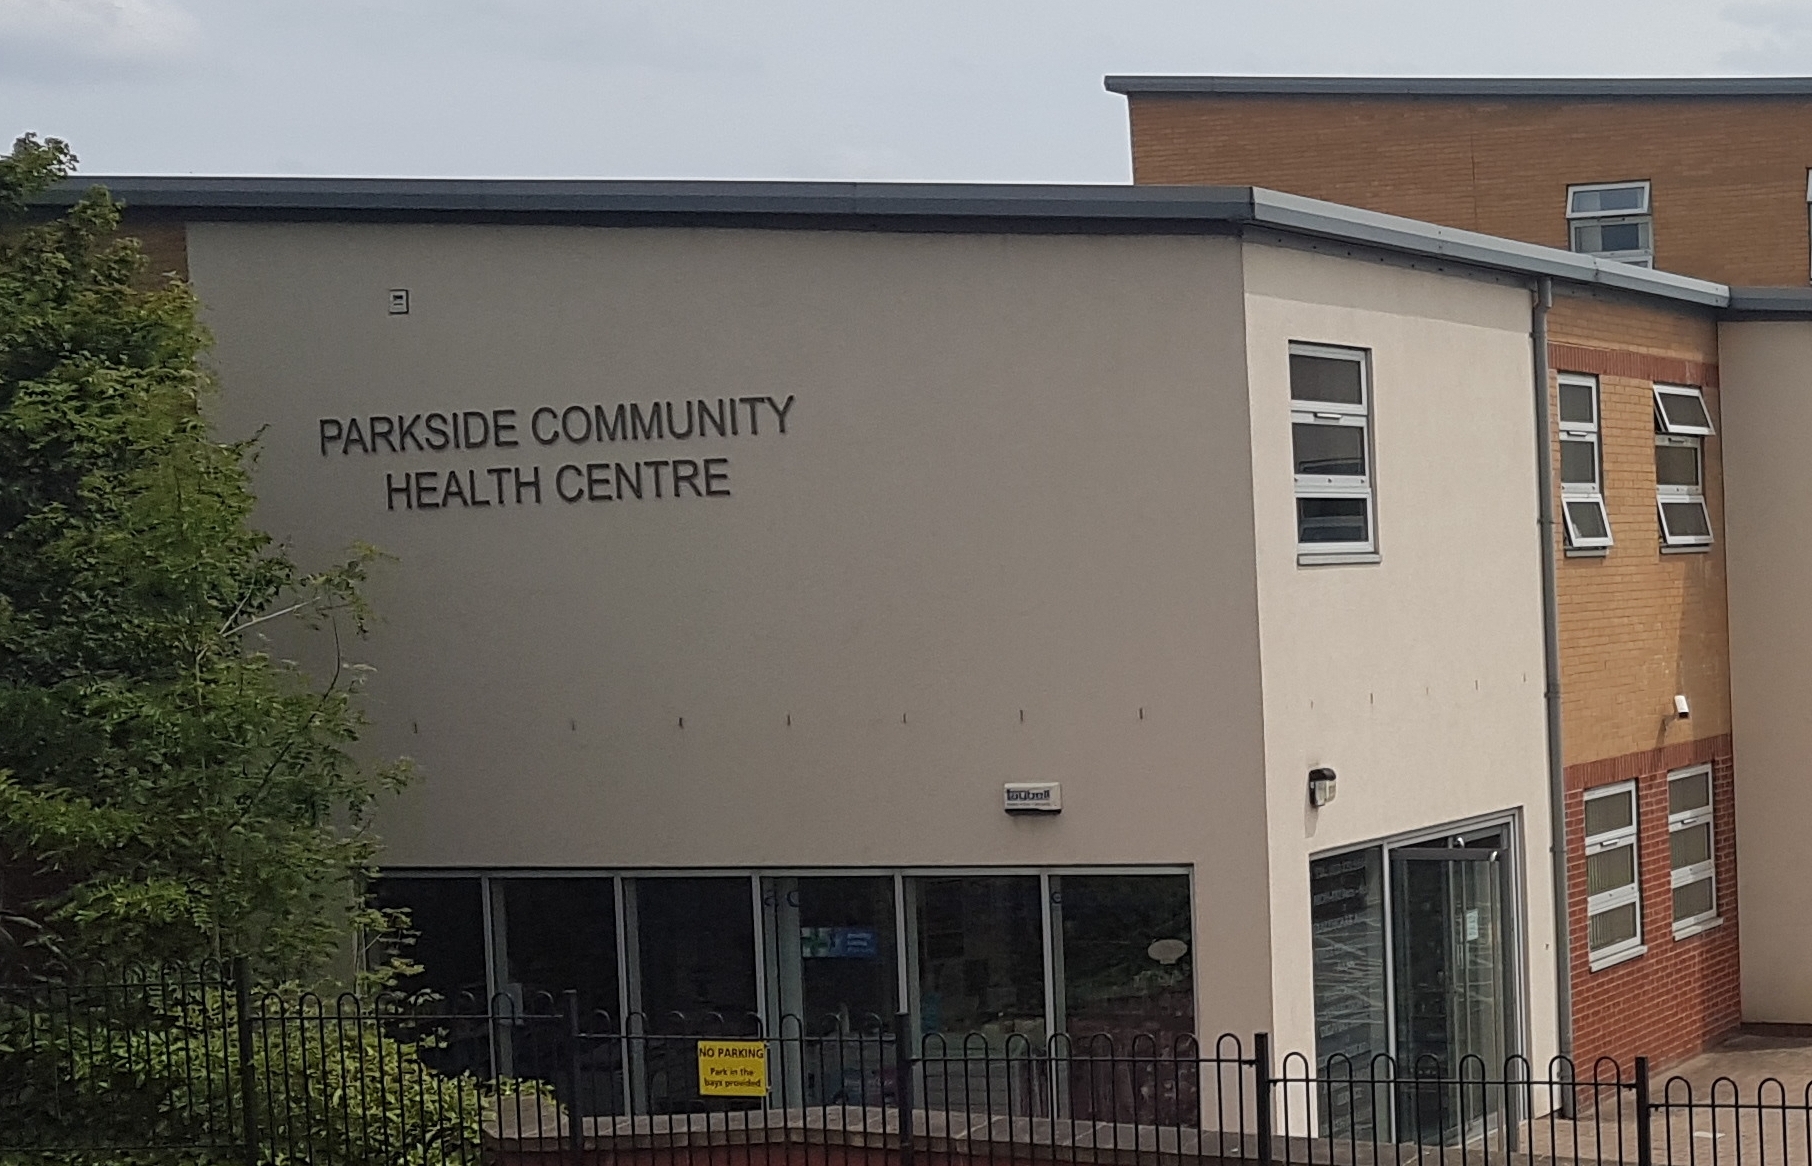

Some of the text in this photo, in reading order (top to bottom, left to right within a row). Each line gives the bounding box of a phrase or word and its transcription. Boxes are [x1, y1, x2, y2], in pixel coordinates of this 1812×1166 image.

[318, 395, 796, 456] PARKSIDE COMMUNITY
[386, 457, 731, 511] HEALTH CENTRE
[699, 1046, 764, 1059] NO PARKING
[710, 1067, 728, 1076] Park
